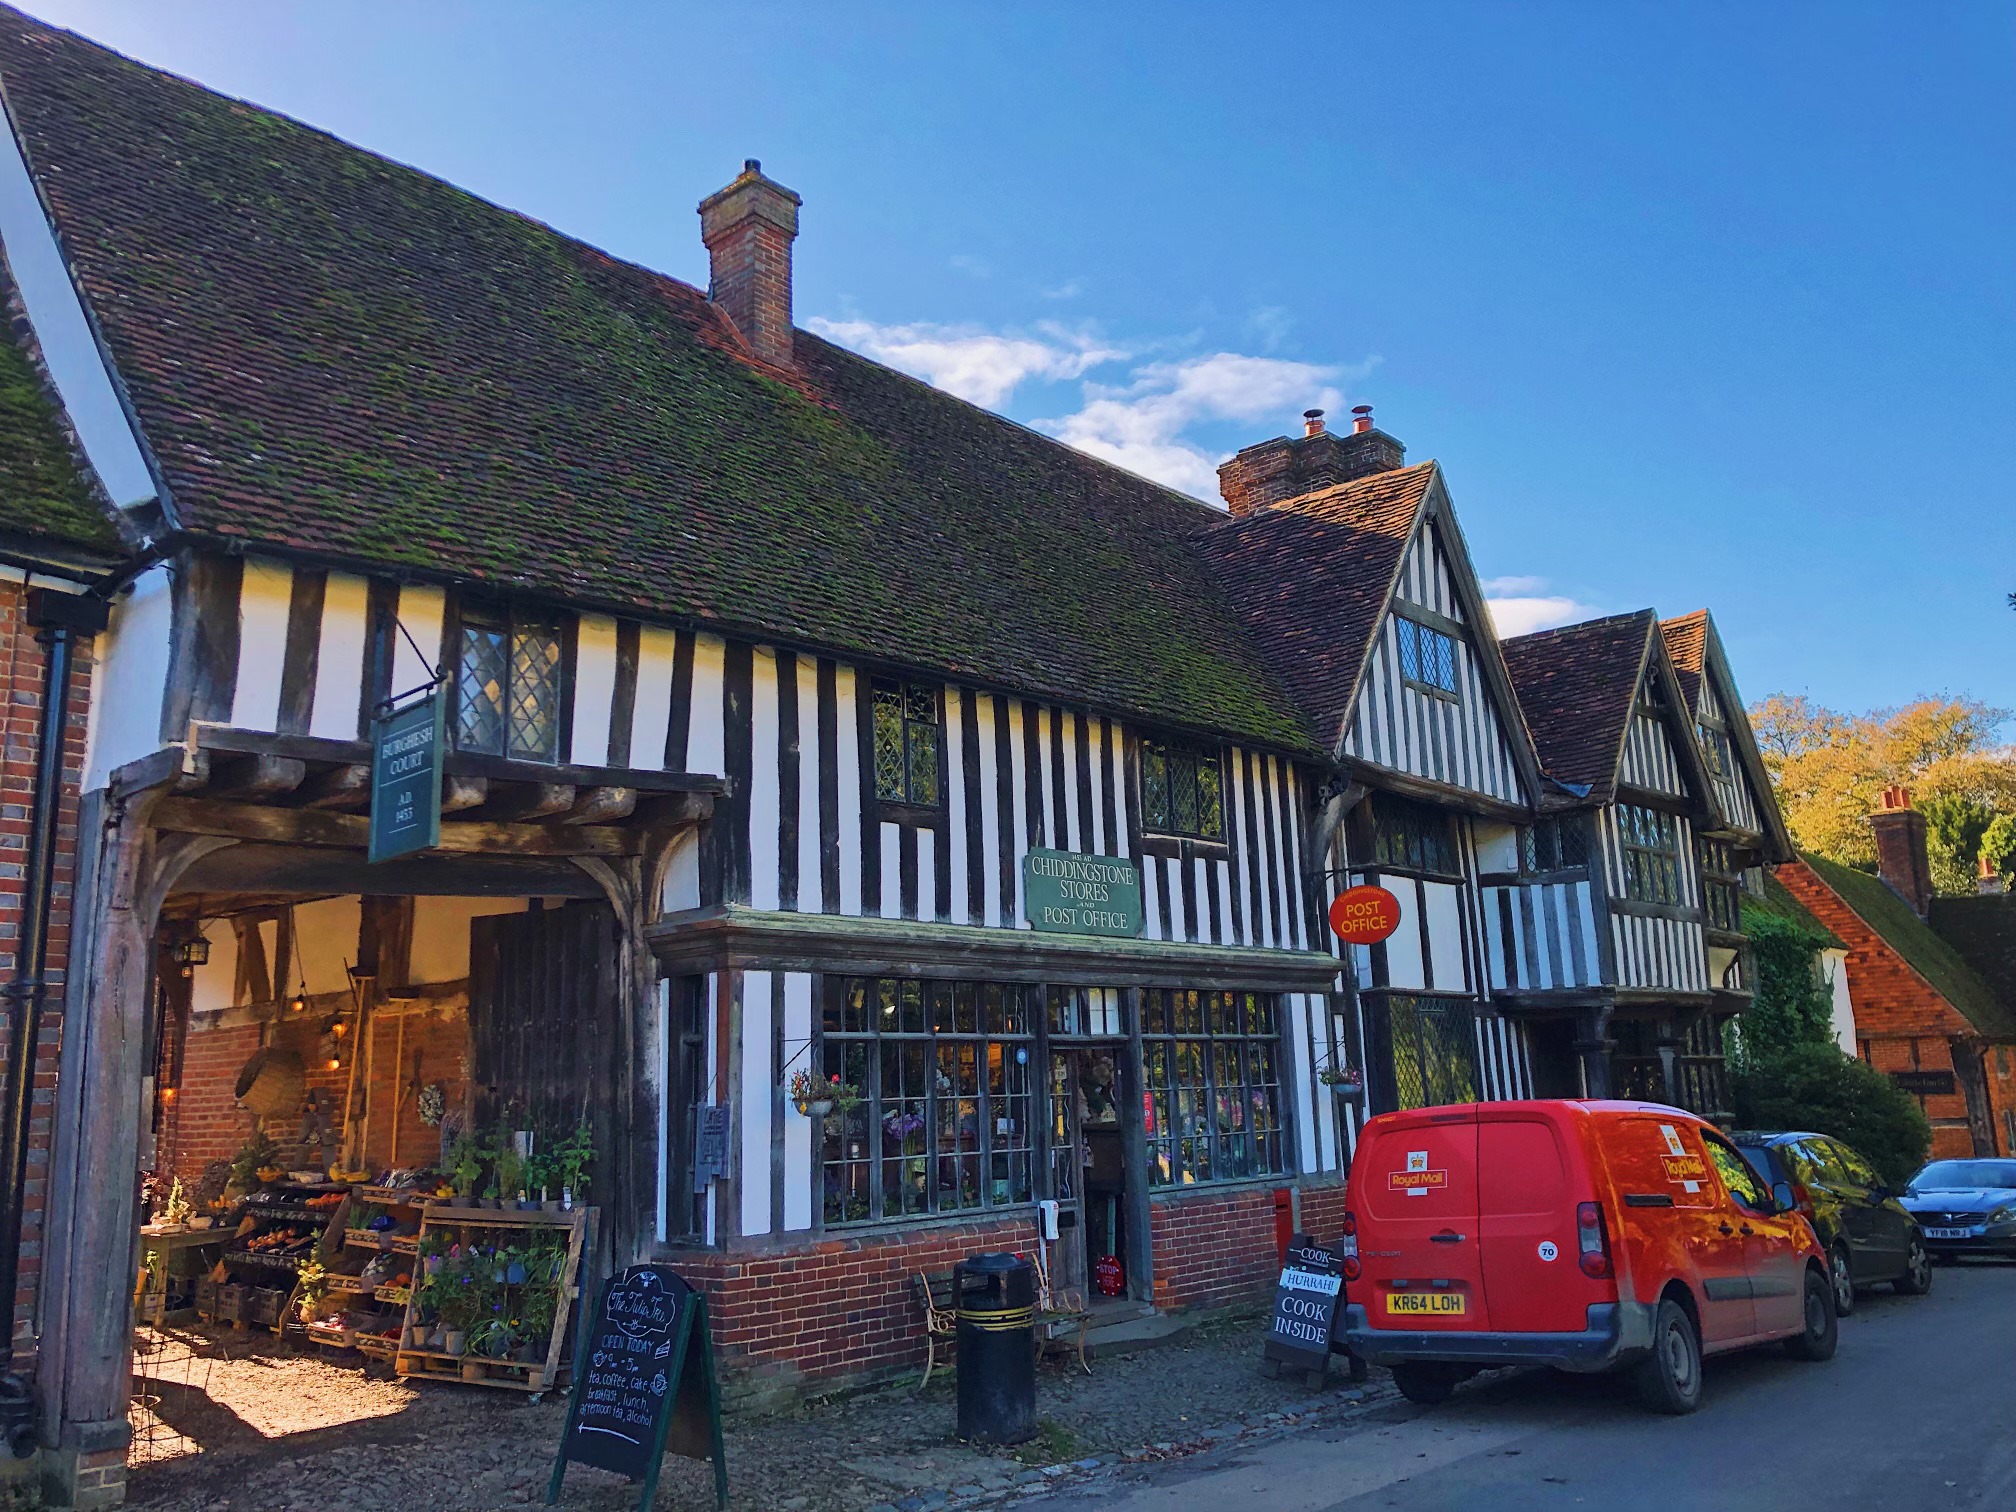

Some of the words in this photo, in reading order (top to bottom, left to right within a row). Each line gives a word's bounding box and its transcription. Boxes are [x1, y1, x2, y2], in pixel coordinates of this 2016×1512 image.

[389, 751, 424, 775] COURT
[1032, 856, 1134, 885] CHIDDINGSTONE
[1060, 879, 1109, 902] STORES
[1044, 906, 1078, 925] POST
[1083, 909, 1128, 929] OFFICE
[1346, 901, 1380, 917] POST
[1341, 915, 1388, 933] OFFICE
[1392, 1173, 1420, 1187] Royal
[1421, 1172, 1443, 1184] Mail
[1301, 1247, 1330, 1264] COOK
[1541, 1248, 1555, 1256] 70
[1100, 1264, 1117, 1275] STOP
[1287, 1273, 1335, 1291] HURRAH!
[609, 1292, 625, 1311] The
[625, 1291, 649, 1318] Tulip
[1281, 1296, 1328, 1322] COOK
[1393, 1296, 1427, 1311] KR64
[1431, 1295, 1460, 1311] LOH
[1274, 1316, 1327, 1344] INSIDE
[602, 1334, 625, 1349] OPEN
[626, 1337, 654, 1355] TODAY
[580, 1403, 612, 1417] afternoon
[626, 1409, 653, 1429] alcohol
